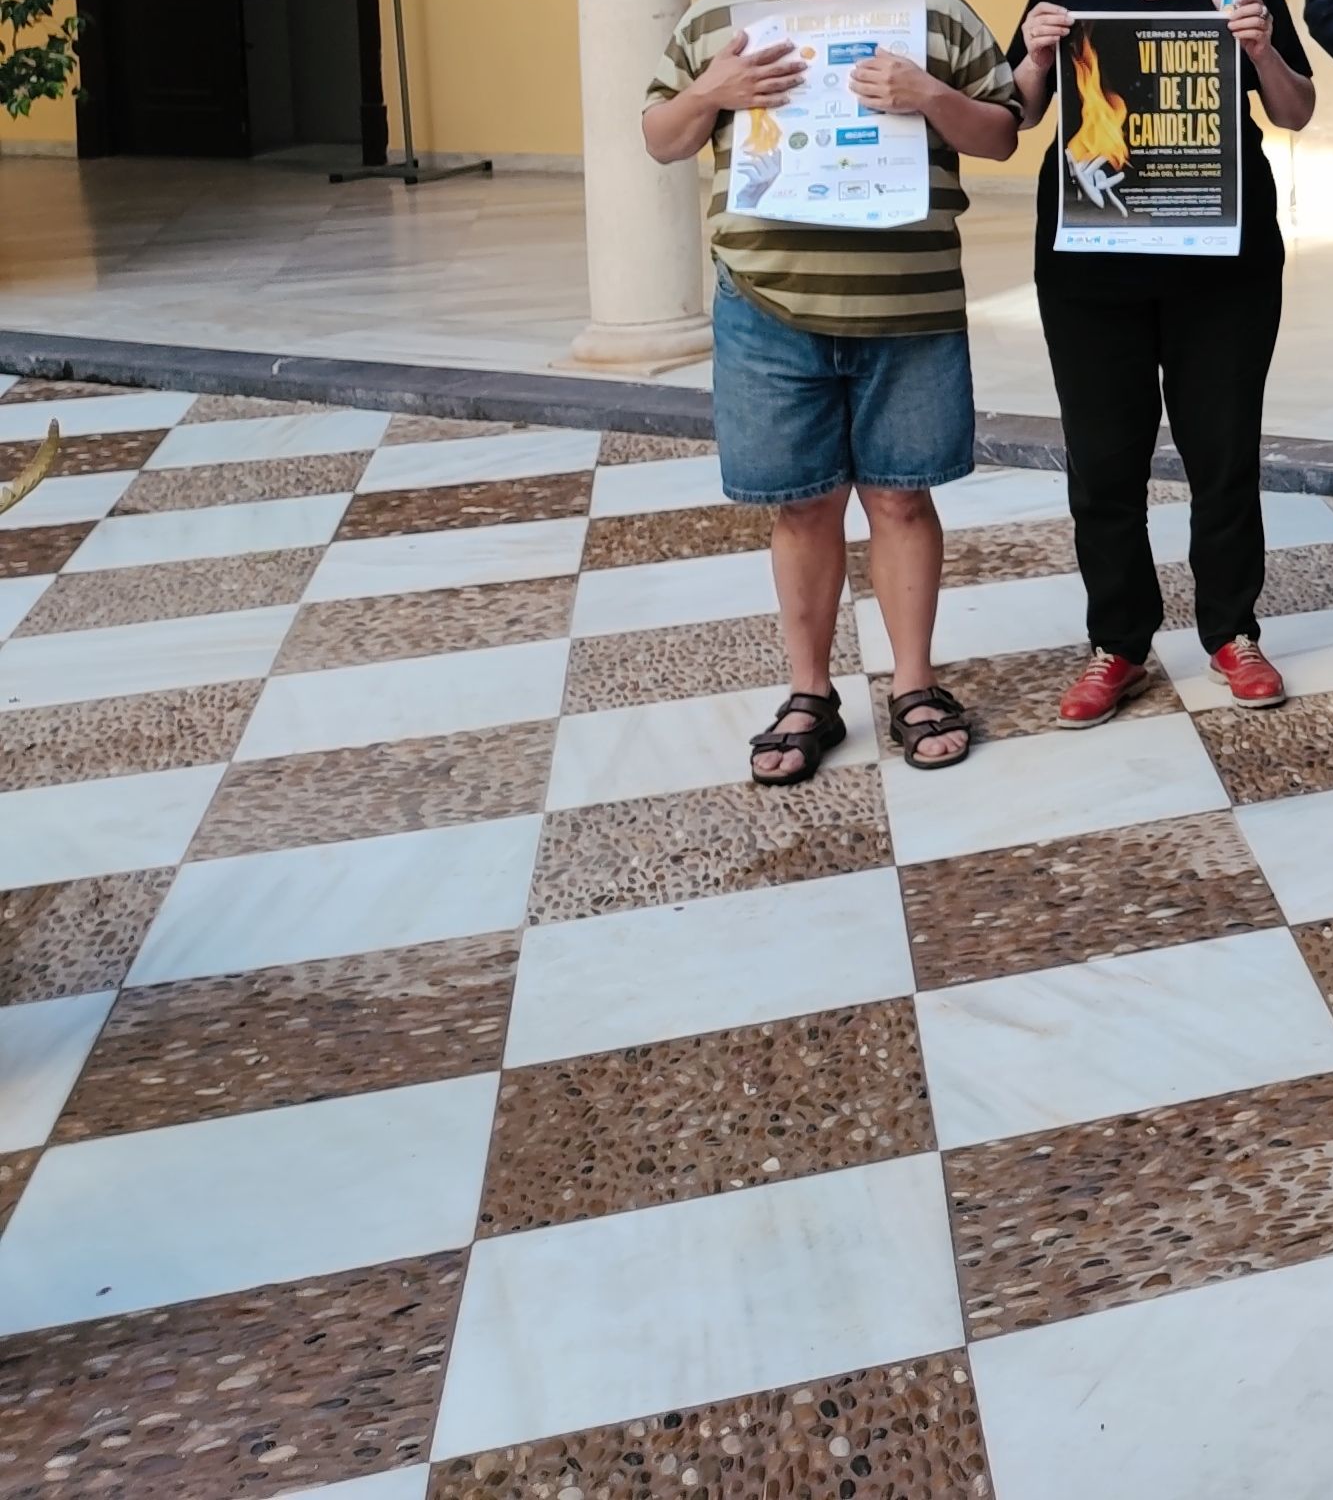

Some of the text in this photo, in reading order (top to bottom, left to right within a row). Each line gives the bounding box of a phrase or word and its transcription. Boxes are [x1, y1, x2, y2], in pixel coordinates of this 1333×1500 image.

[1189, 30, 1220, 38] JUNIO
[1138, 40, 1220, 74] VI NOCHE
[1159, 76, 1221, 110] DE LAS
[1128, 112, 1221, 147] CANDELAS
